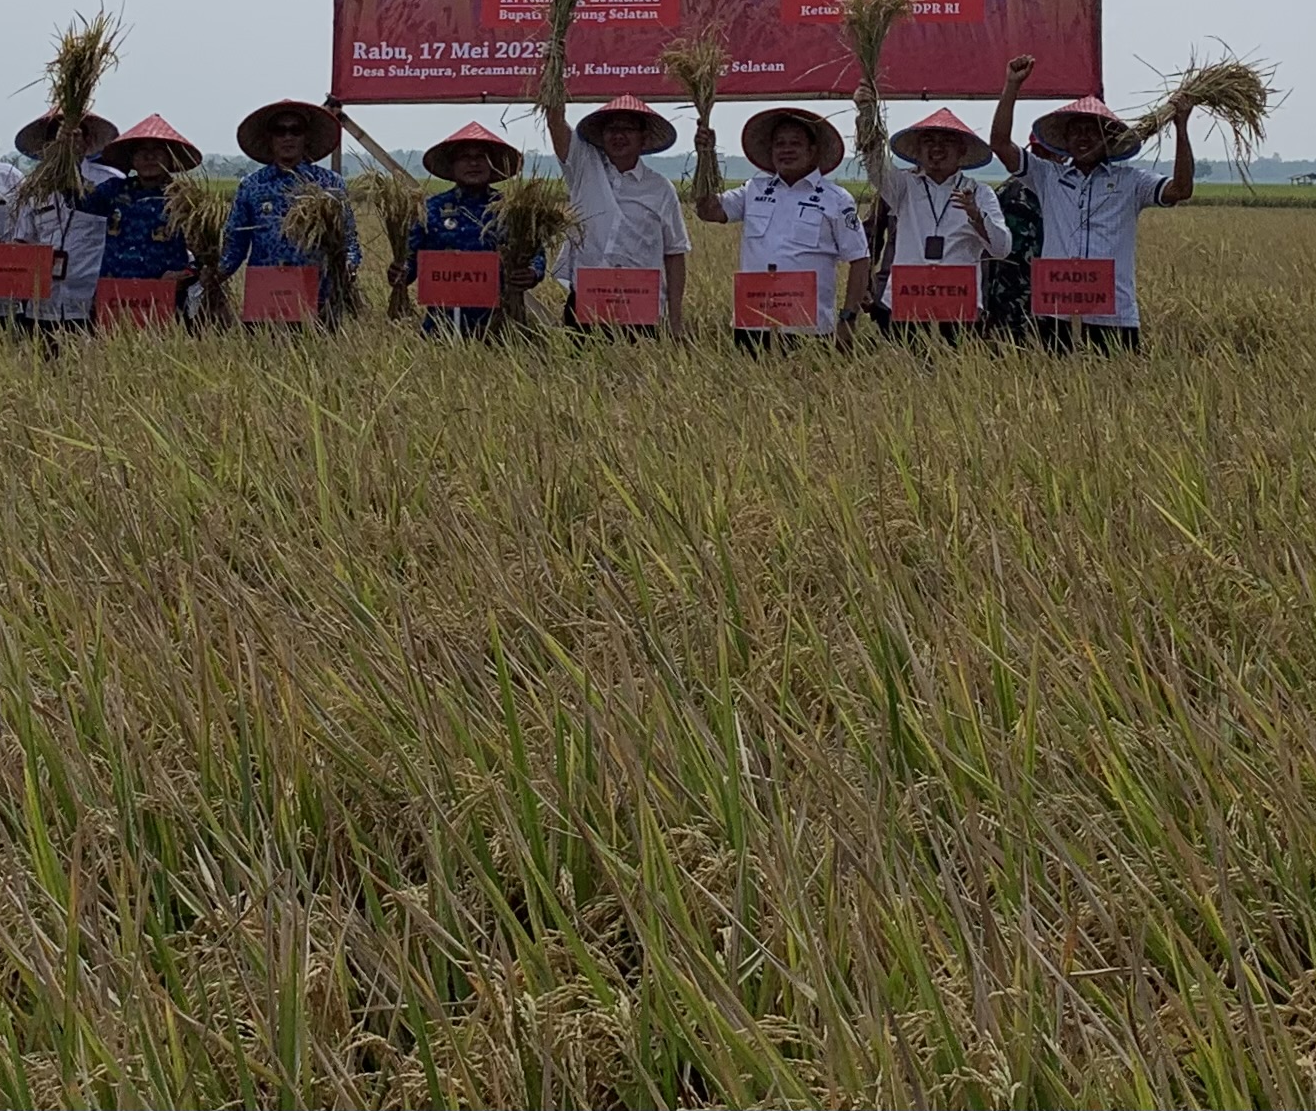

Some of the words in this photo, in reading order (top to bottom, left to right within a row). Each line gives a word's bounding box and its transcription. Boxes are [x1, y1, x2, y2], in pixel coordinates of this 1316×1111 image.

[913, 3, 942, 15] DPR
[944, 2, 961, 15] RI
[499, 9, 542, 23] Bupati
[609, 8, 659, 20] Selatan
[353, 42, 413, 64] Rabu,
[420, 42, 446, 59] 17
[450, 41, 490, 59] Mei
[495, 41, 547, 59] 2023
[352, 65, 385, 78] Desa
[388, 64, 457, 80] Sukapura,
[461, 64, 537, 76] Kecamatan
[584, 63, 660, 78] Kabupaten
[731, 60, 785, 73] Selatan
[431, 270, 488, 284] BUPATI
[1049, 270, 1099, 283] KADIS
[898, 285, 969, 297] ASISTEN
[1042, 292, 1107, 304] TPHBUN
